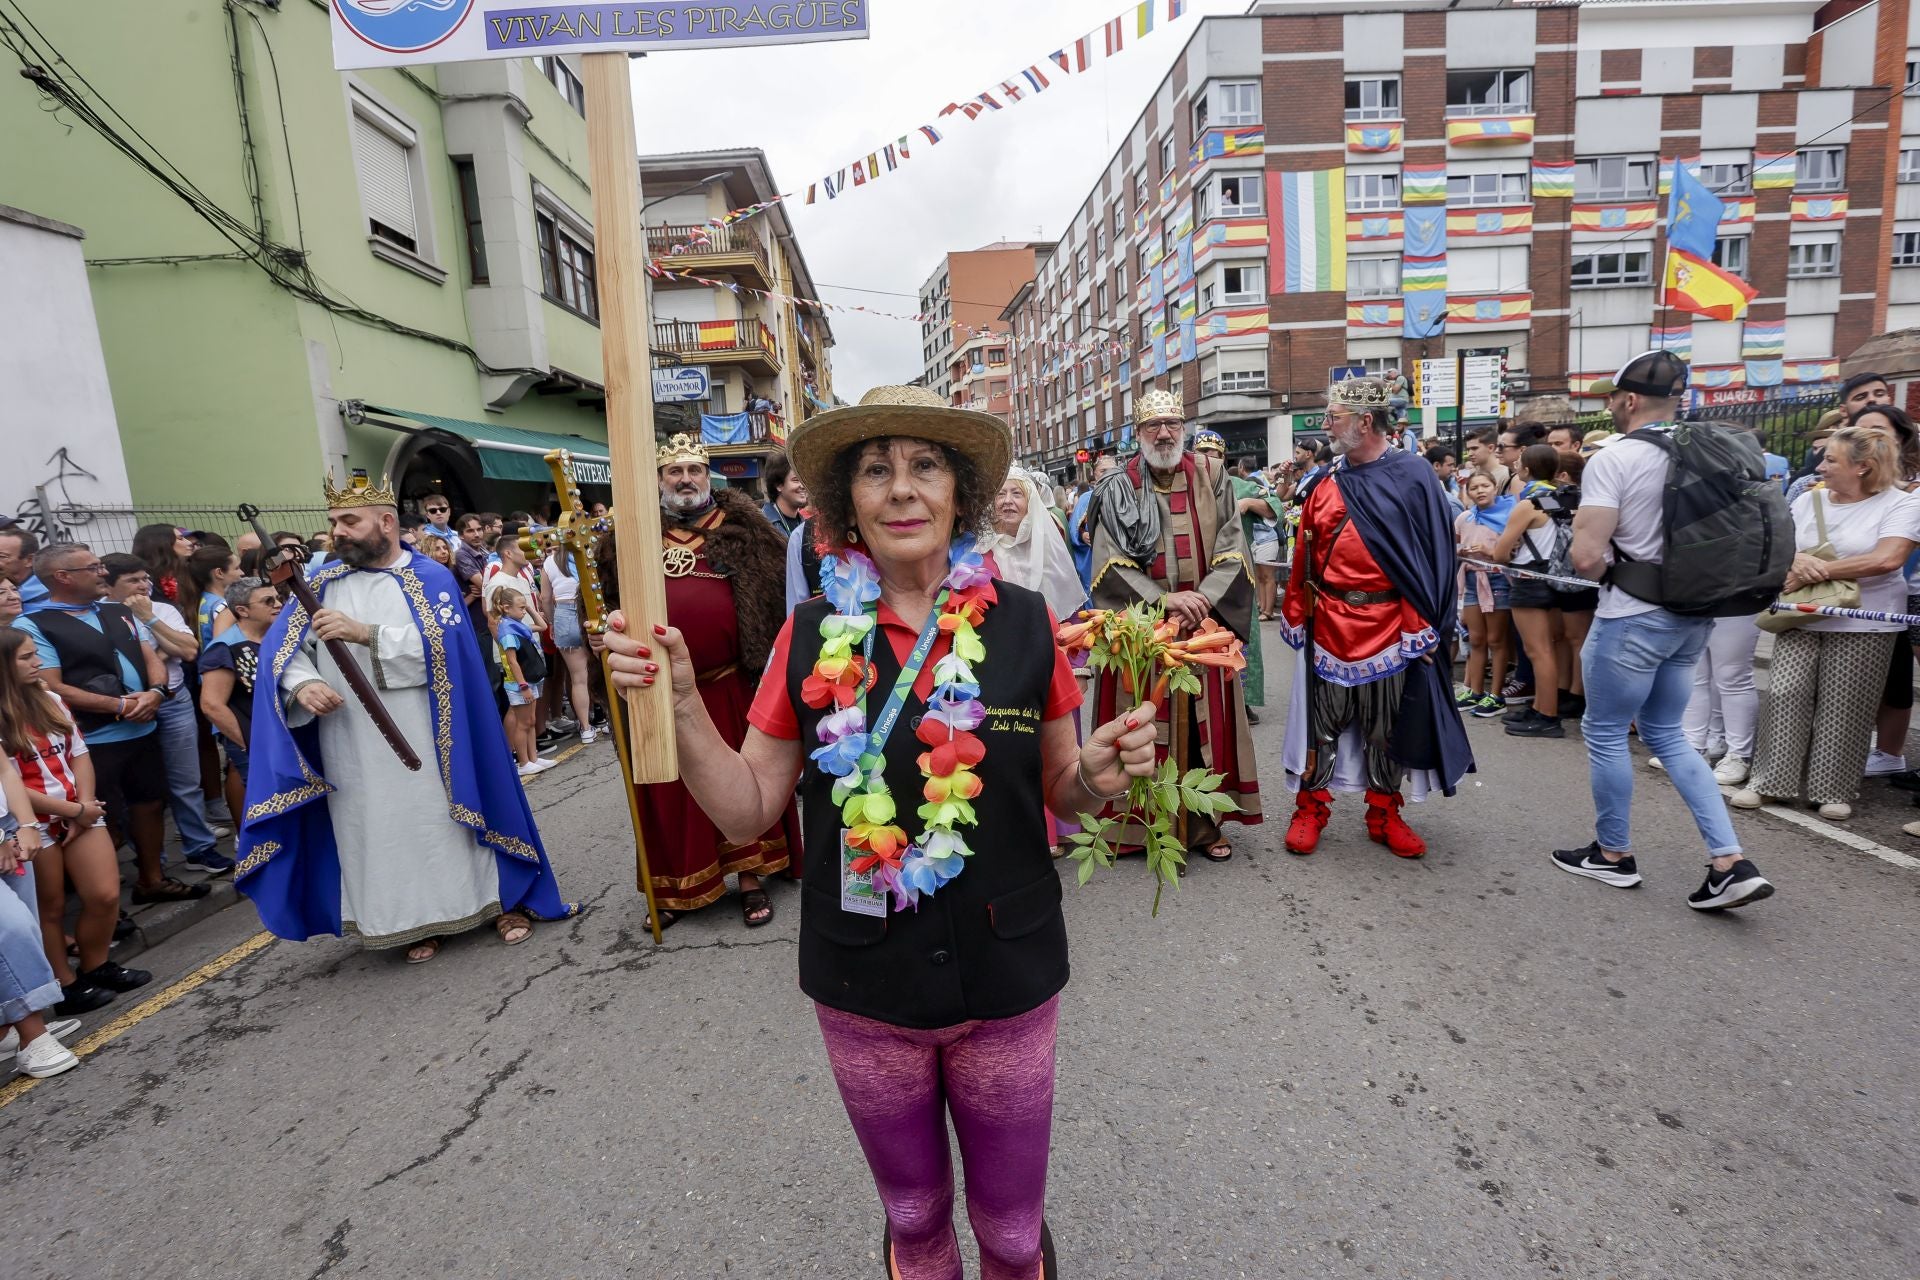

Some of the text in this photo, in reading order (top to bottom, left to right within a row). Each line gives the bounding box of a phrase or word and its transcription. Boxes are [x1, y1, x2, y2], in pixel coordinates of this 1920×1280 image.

[490, 0, 859, 44] VIVAN LES PIRAGÜES
[656, 381, 701, 395] CAMPOAMOR
[1304, 415, 1324, 427] OP
[572, 461, 612, 483] FITERIA
[920, 626, 937, 652] Unicaja
[879, 707, 898, 735] Unicaja
[990, 720, 1010, 731] Loli
